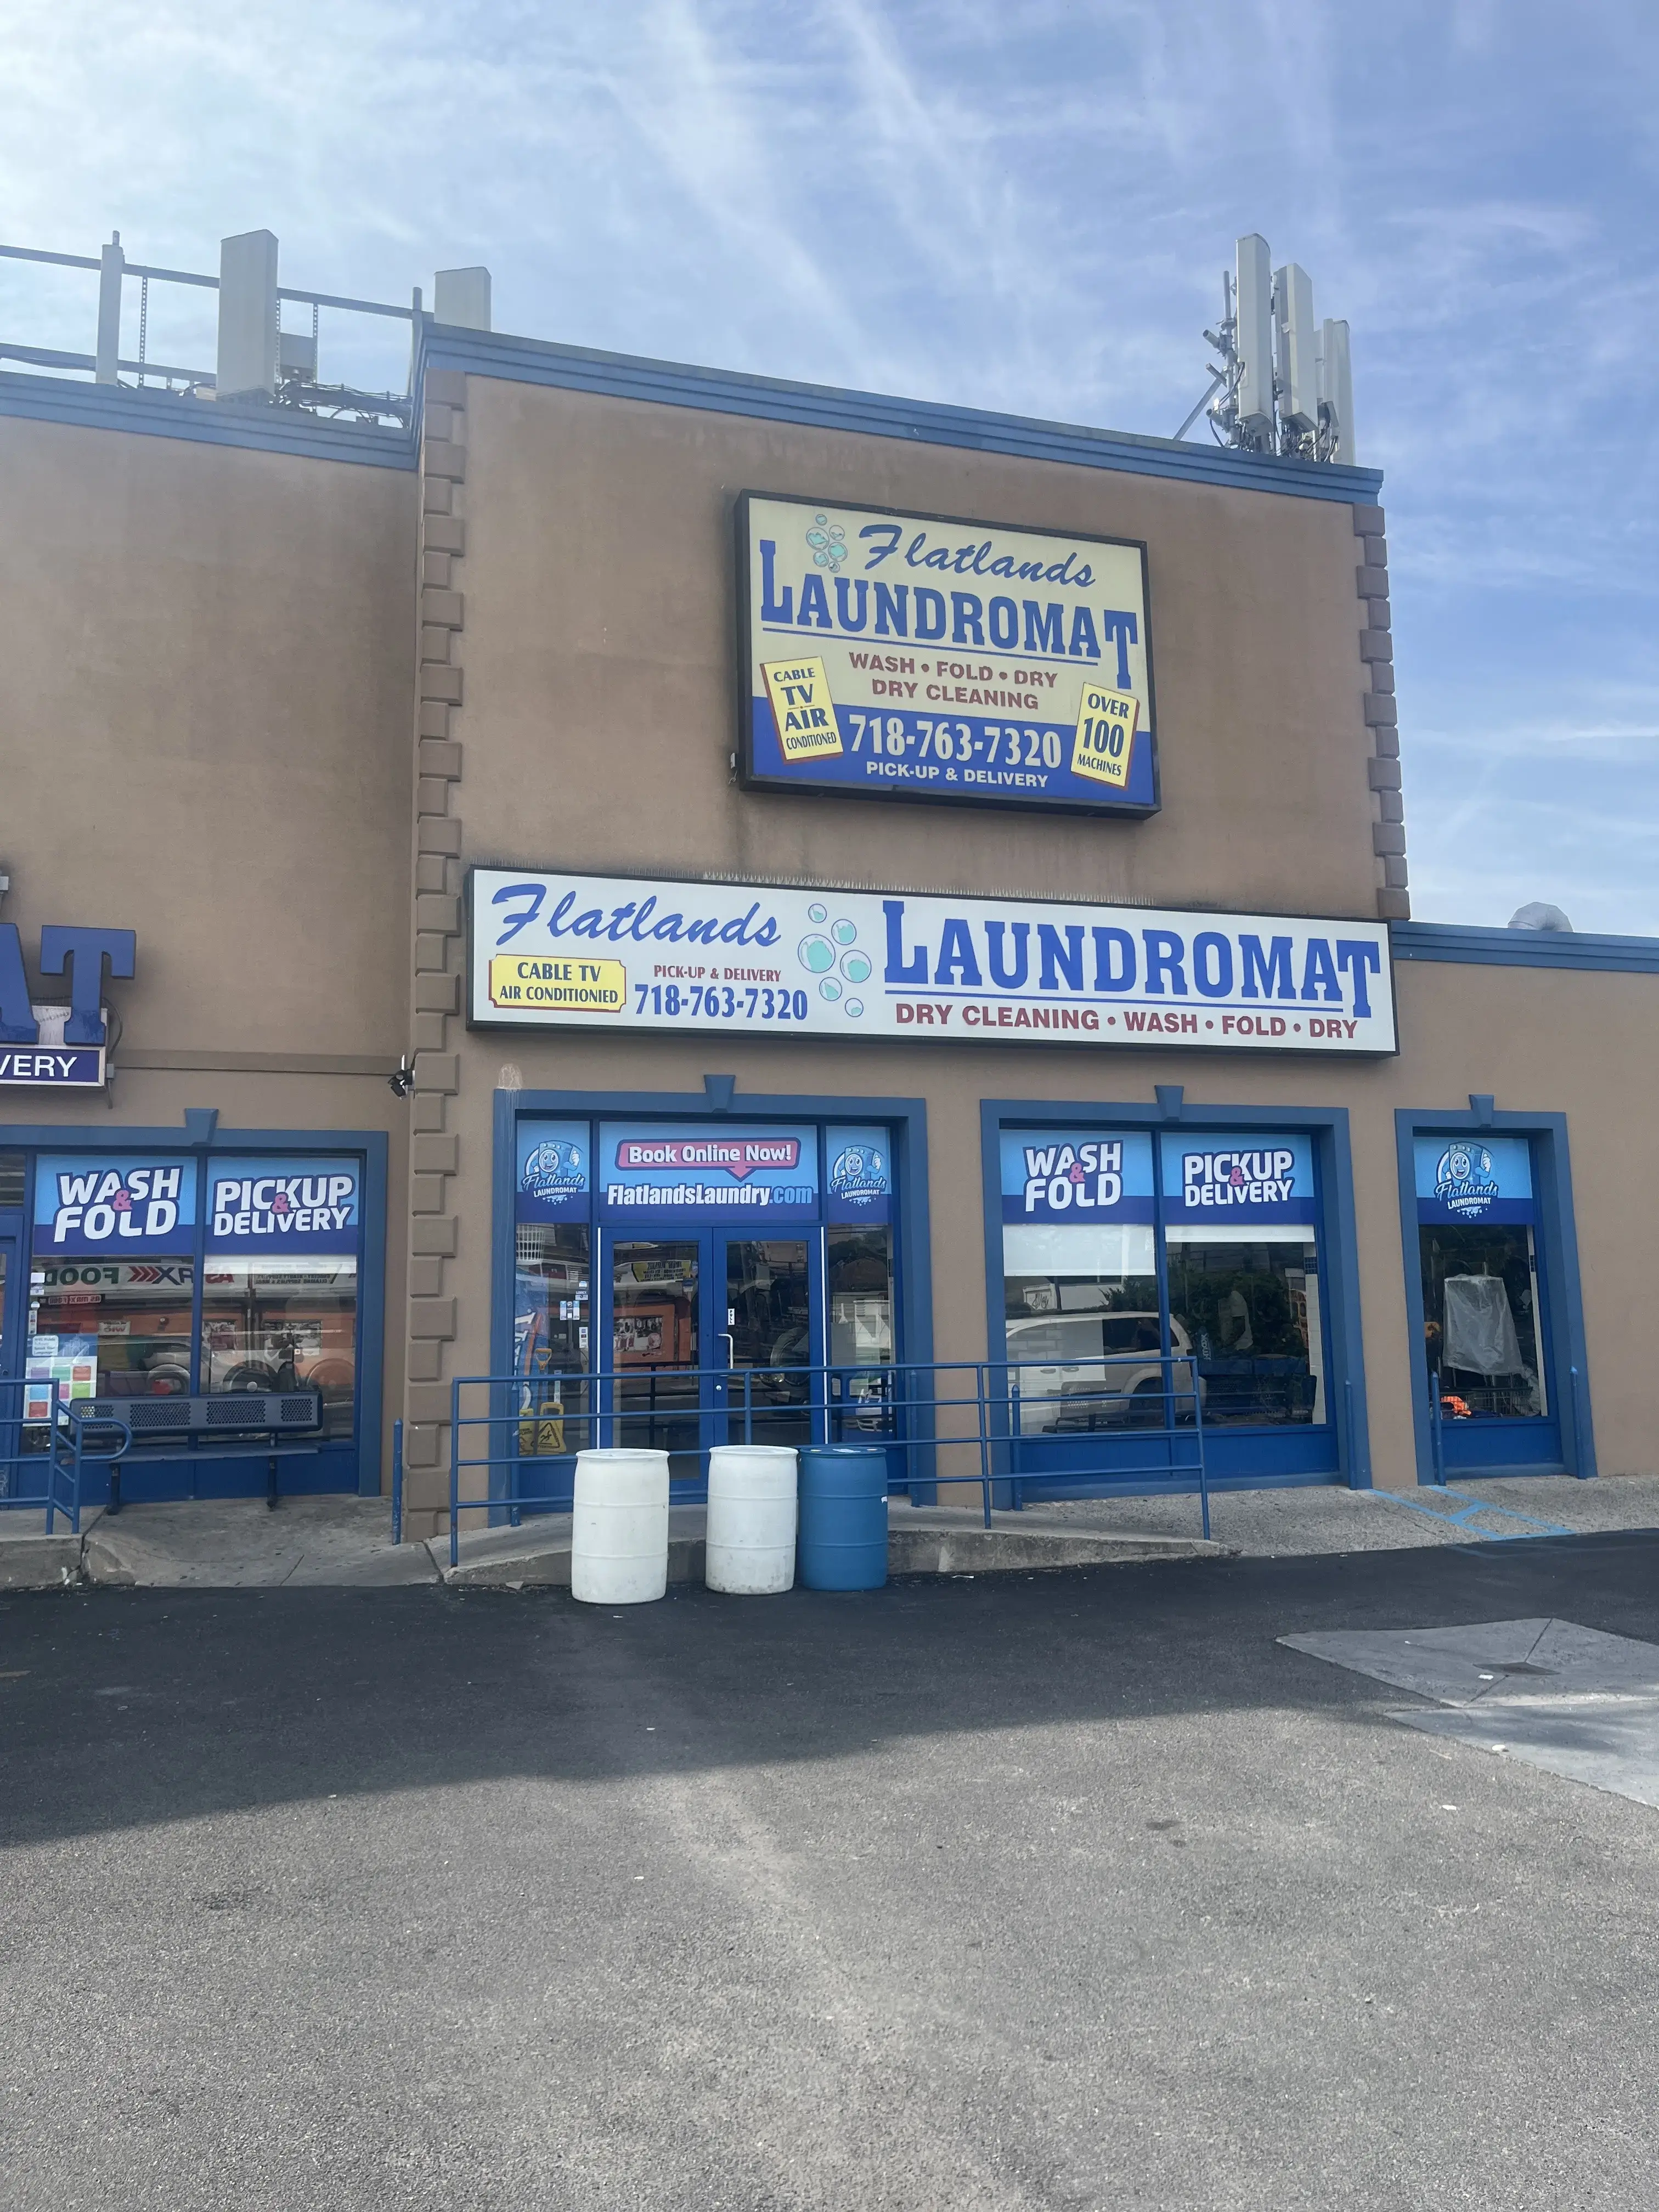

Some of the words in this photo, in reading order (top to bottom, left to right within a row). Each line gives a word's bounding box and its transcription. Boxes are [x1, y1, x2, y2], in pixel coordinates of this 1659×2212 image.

[859, 524, 1096, 588] Flatlands
[761, 540, 1137, 690] LAUNDROMAT
[774, 667, 815, 682] CABLE
[850, 652, 915, 675] WASH
[936, 661, 993, 681] FOLD
[1014, 670, 1058, 688] DRY
[781, 684, 813, 705] TV
[872, 679, 916, 699] DRY
[927, 684, 1038, 709] CLEANING
[1087, 693, 1129, 719] OVER
[785, 707, 829, 732] AIR
[786, 731, 837, 750] CONDITIONED
[849, 714, 1061, 768] 718-763-7320
[1084, 716, 1124, 758] 100
[866, 761, 939, 780] PICK-UP
[945, 768, 958, 782] &
[964, 769, 1048, 788] DELIVERY
[1077, 755, 1122, 776] MACHINES
[491, 883, 781, 946] Flatlands
[883, 900, 1380, 1018] LAUNDROMAT
[517, 962, 572, 980] CABLE
[578, 964, 602, 983] TV
[653, 964, 706, 979] PICK-UP
[710, 967, 719, 980] &
[724, 967, 781, 982] DELIVERY
[499, 985, 522, 1000] AIR
[526, 986, 618, 1004] CONDITIONIED
[634, 984, 808, 1020] 718-763-7320
[896, 1003, 953, 1025] DRY
[962, 1005, 1099, 1030] CLEANING
[1124, 1011, 1198, 1034] WASH
[1222, 1015, 1286, 1037] FOLD
[1309, 1018, 1357, 1039] DRY
[628, 1146, 676, 1163] Book
[682, 1144, 740, 1162] Online
[745, 1144, 792, 1161] Now!
[1026, 1142, 1121, 1177] WASH
[1069, 1163, 1085, 1182] &
[1184, 1151, 1293, 1184] PICKUP
[1229, 1167, 1244, 1186] &
[60, 1169, 180, 1205] WASH
[217, 1176, 353, 1212] PICKUP
[523, 1173, 584, 1191] Flatlands
[533, 1187, 577, 1198] LAUNDROMAT
[608, 1183, 812, 1206] FlatlandsLaundry.com
[831, 1177, 885, 1192] Flatlands
[841, 1189, 879, 1199] LAUNDROMAT
[1025, 1172, 1121, 1212] FOLD
[1184, 1180, 1293, 1207] DELIVERY
[1435, 1181, 1498, 1202] Flatlands
[113, 1189, 133, 1211] &
[272, 1193, 289, 1214] &
[1448, 1197, 1491, 1210] LAUNDROMAT
[53, 1200, 177, 1243] FOLD
[214, 1207, 351, 1236] DELIVERY
